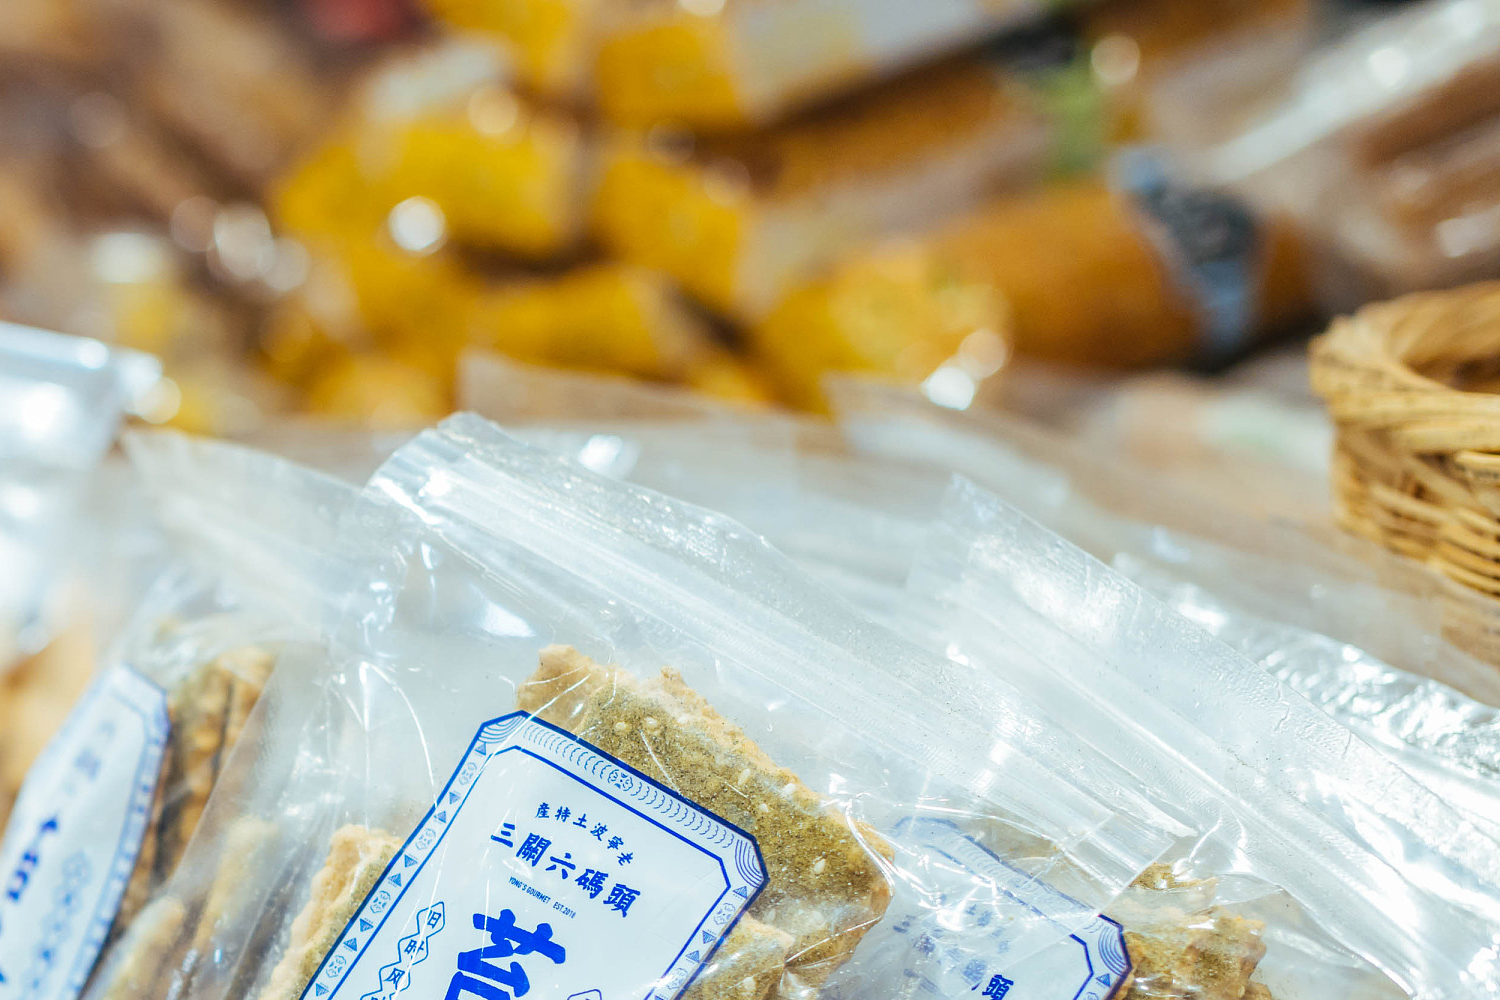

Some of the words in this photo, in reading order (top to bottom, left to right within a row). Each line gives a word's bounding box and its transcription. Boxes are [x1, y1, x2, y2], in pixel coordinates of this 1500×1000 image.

[490, 822, 641, 918] 三關六碼頭
[526, 886, 551, 904] GOURMET
